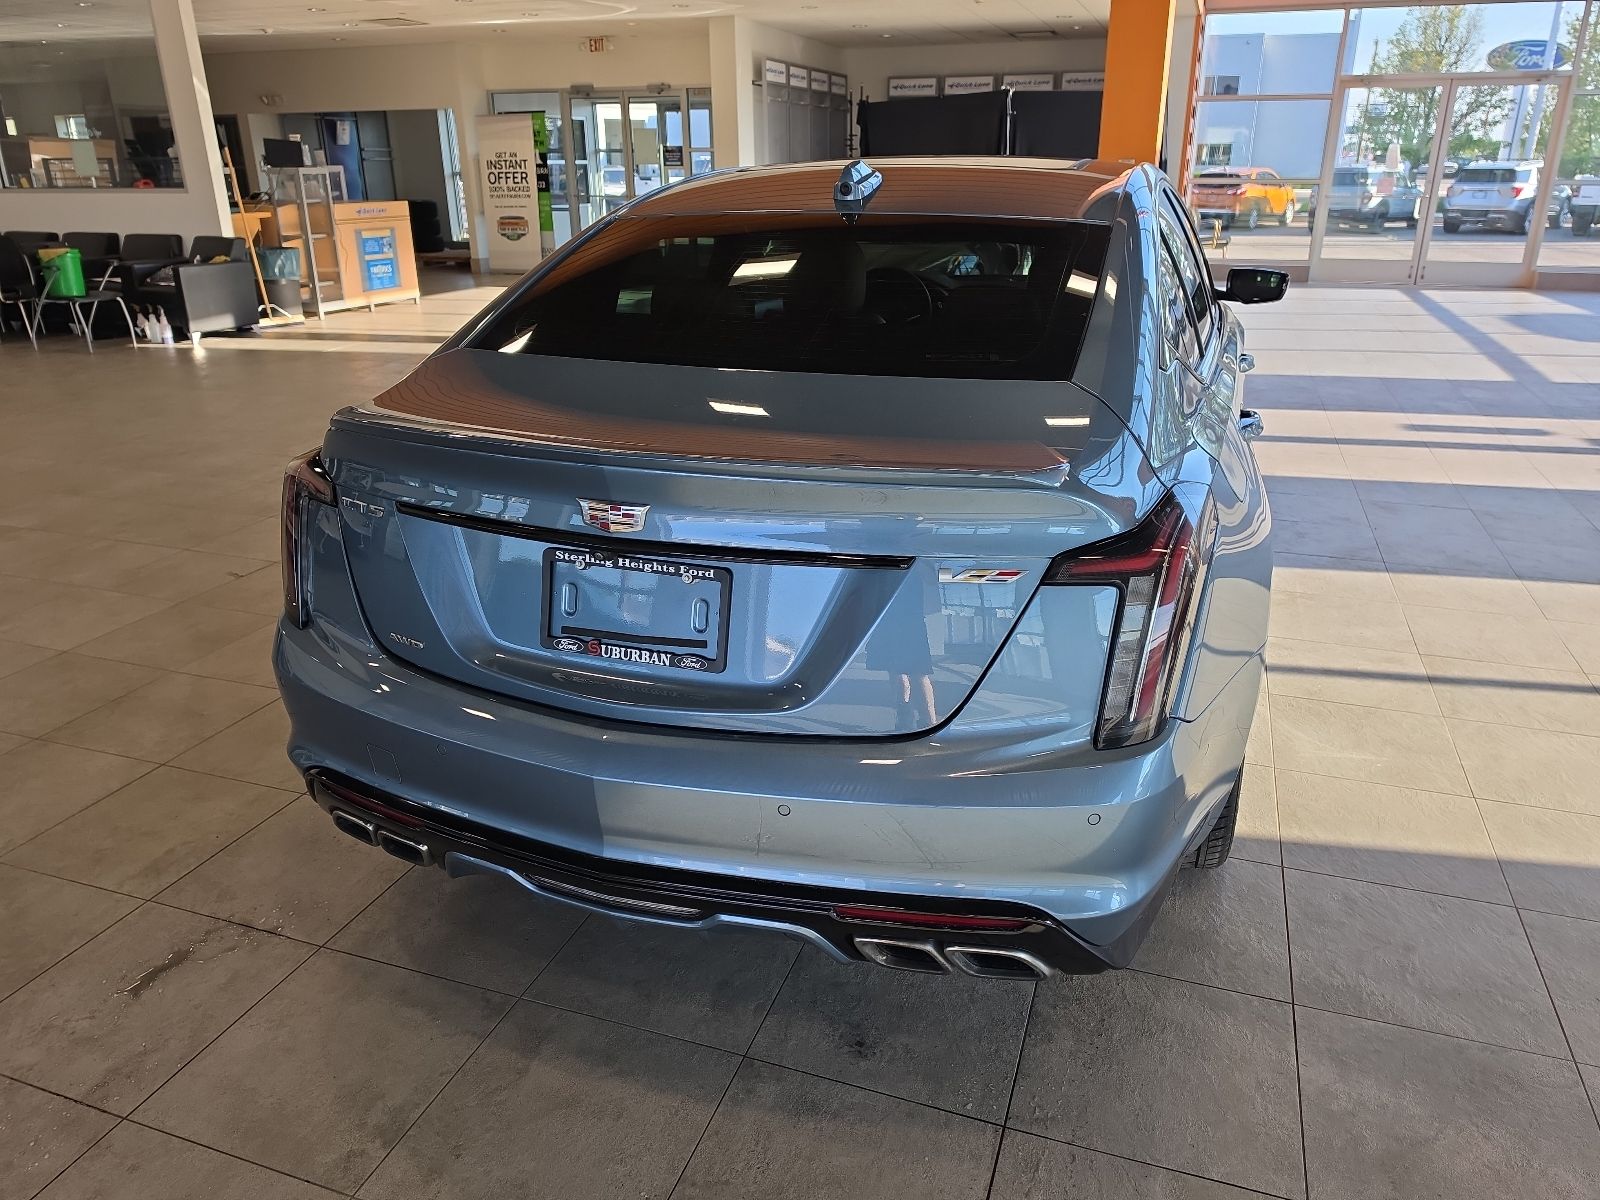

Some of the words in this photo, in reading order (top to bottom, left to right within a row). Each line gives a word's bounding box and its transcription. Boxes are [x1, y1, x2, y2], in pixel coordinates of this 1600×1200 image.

[589, 38, 604, 52] EXIT
[495, 151, 507, 159] GET
[486, 159, 529, 170] INSTANT
[487, 171, 529, 185] OFFER
[617, 557, 675, 574] Heights
[679, 565, 715, 578] Ford
[558, 639, 579, 651] Ford
[587, 639, 671, 666] SUBURBAN
[680, 656, 702, 670] Ford
